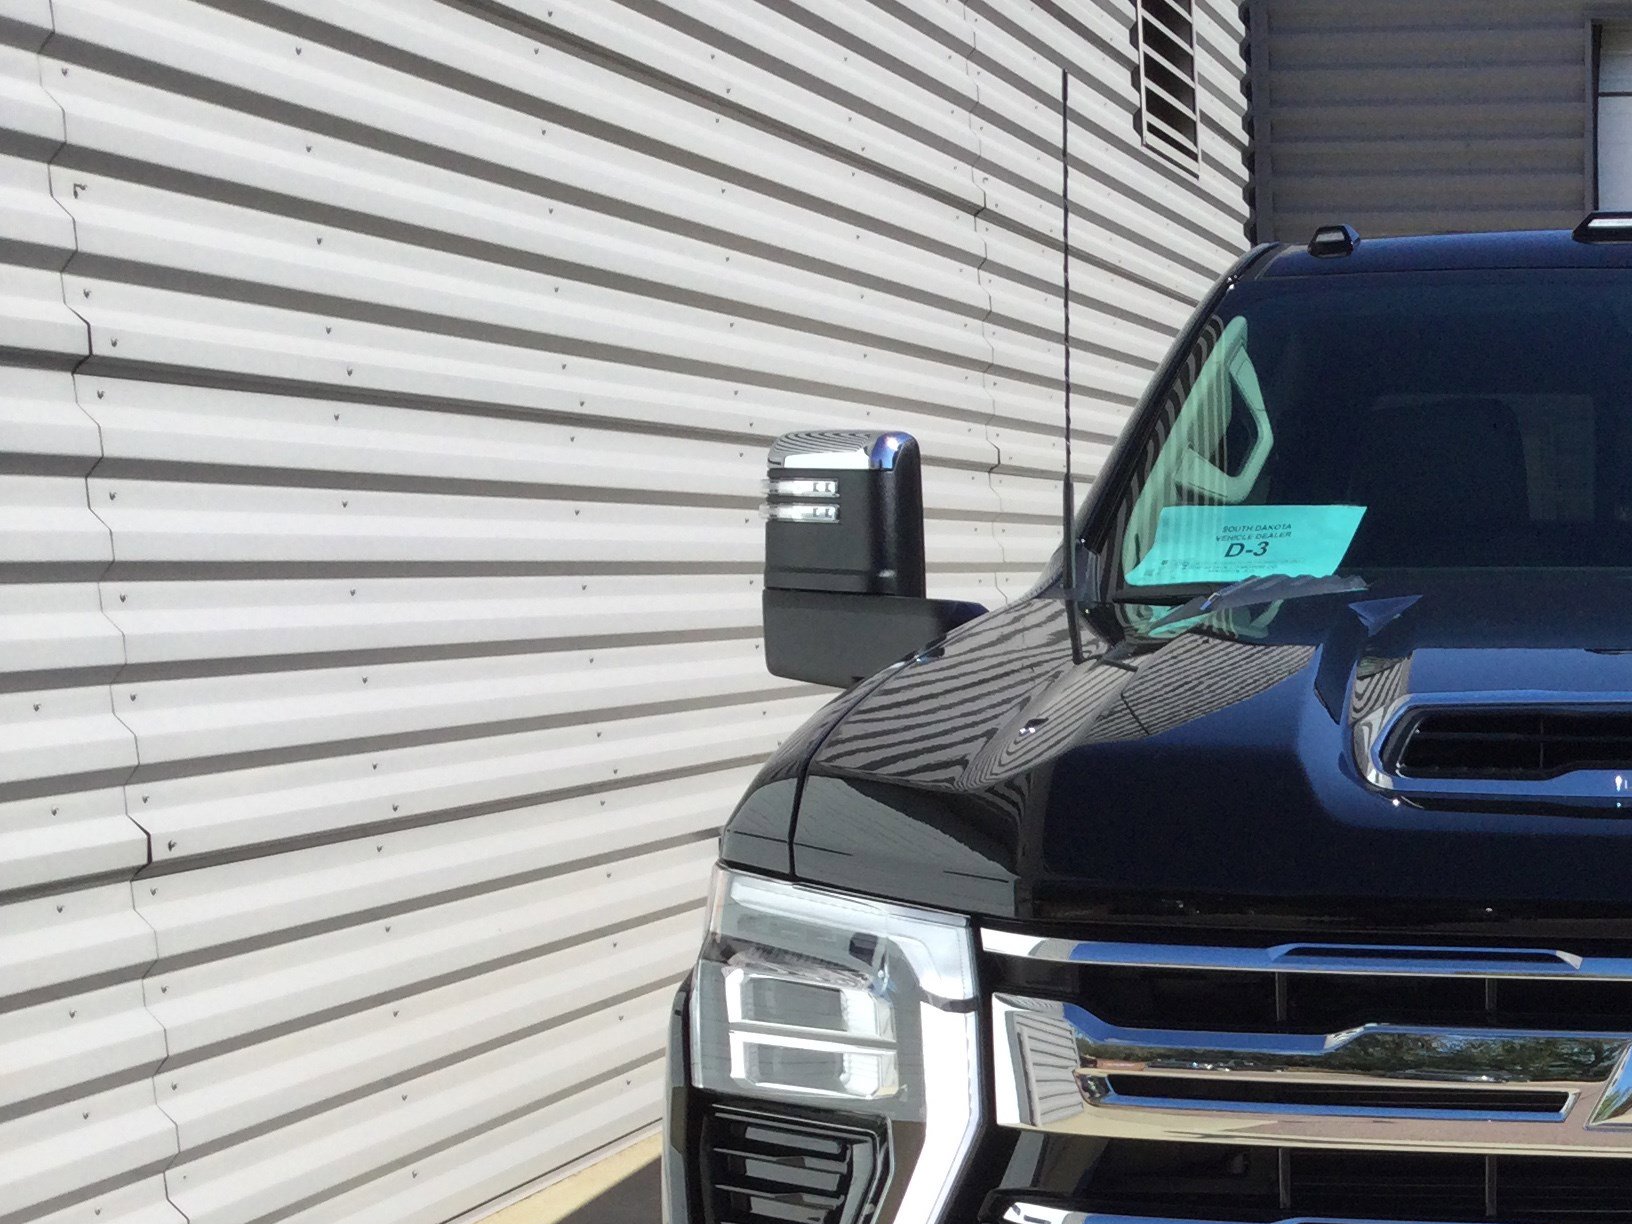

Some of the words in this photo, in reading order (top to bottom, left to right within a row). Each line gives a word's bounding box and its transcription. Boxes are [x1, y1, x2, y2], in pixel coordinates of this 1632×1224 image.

[1222, 525, 1253, 533] SOUTH
[1255, 523, 1292, 531] DAKOTA
[1224, 541, 1269, 557] D-3
